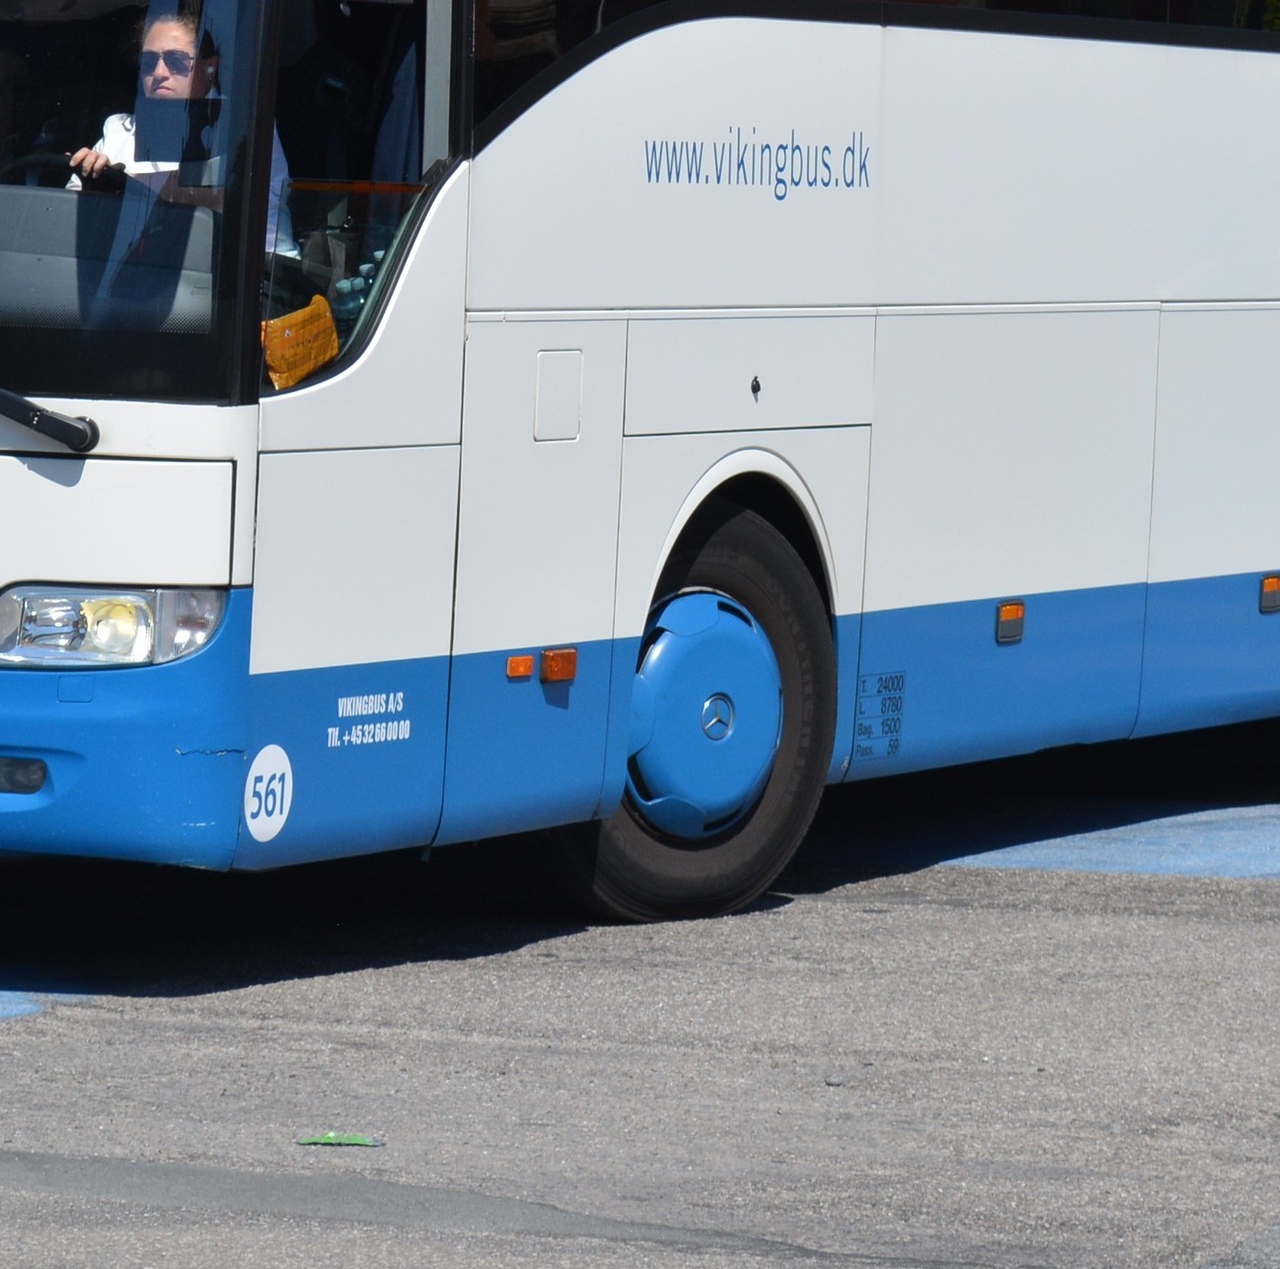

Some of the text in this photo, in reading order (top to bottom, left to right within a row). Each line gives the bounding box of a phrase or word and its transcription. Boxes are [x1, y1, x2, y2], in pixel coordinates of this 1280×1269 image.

[644, 125, 871, 201] www.vikingbus.dk
[876, 675, 904, 693] 24000
[338, 692, 404, 717] VIKINGBUS A/S
[880, 696, 902, 714] 8780
[880, 717, 901, 735] 1500
[328, 727, 341, 747] Tlf.
[887, 738, 899, 755] 59
[250, 772, 286, 820] 561
